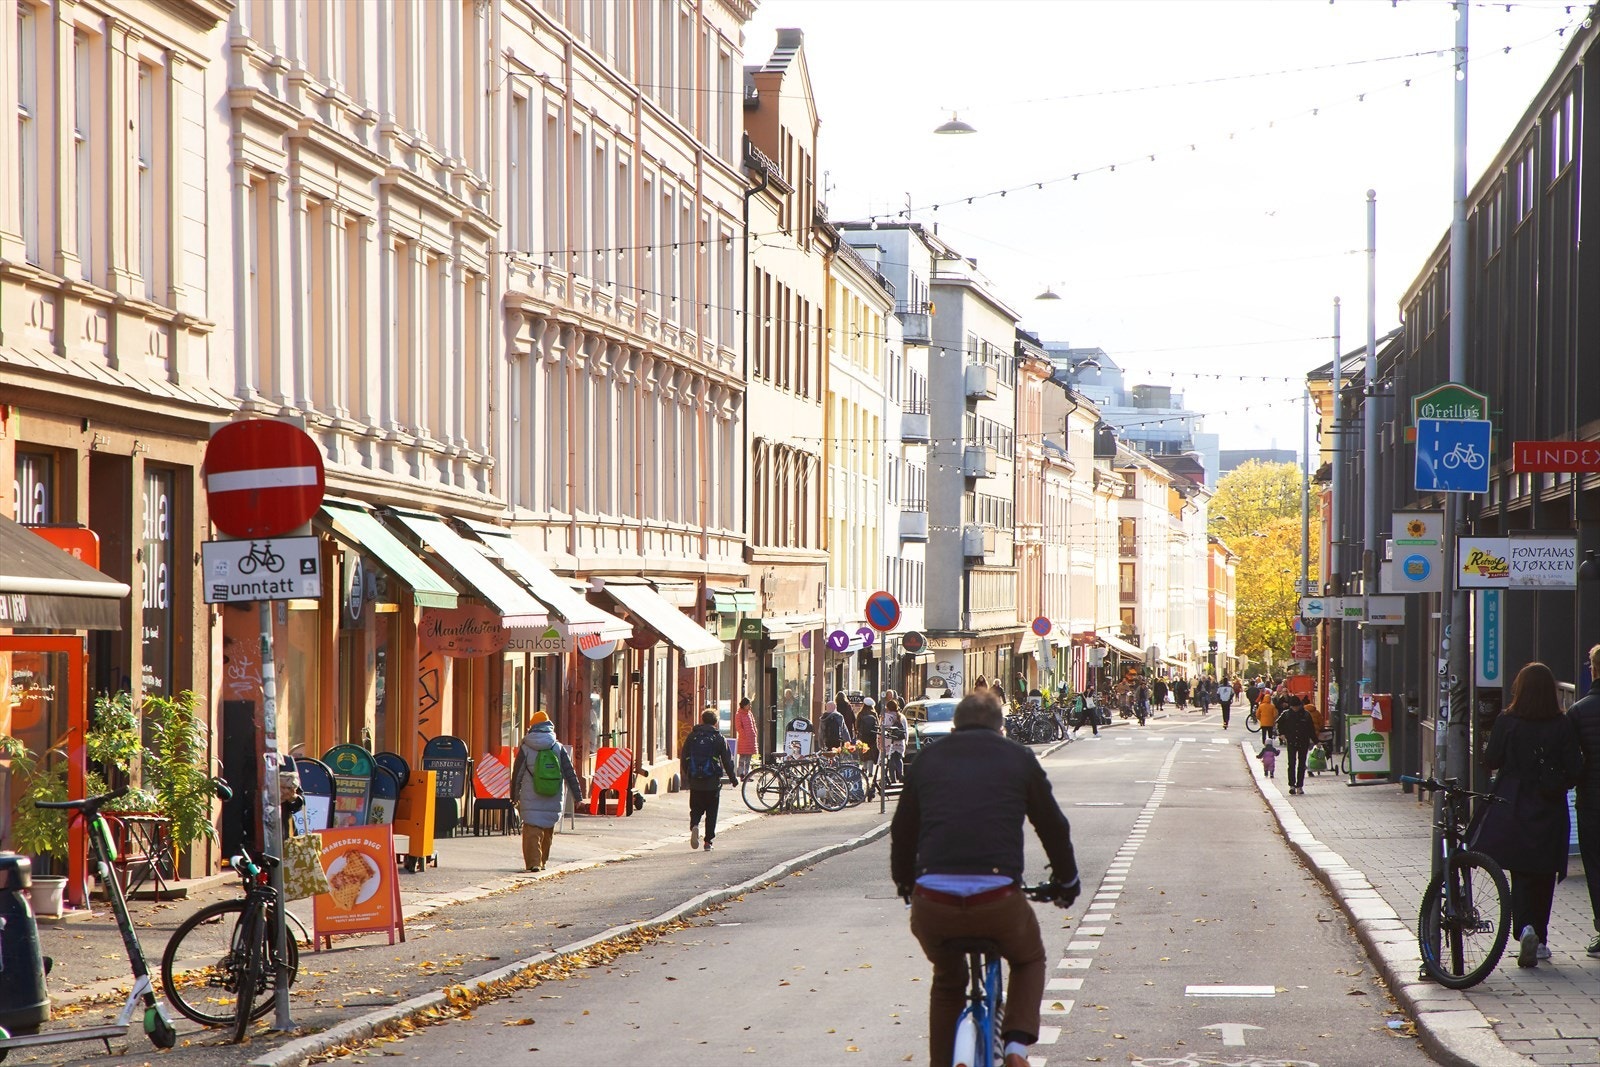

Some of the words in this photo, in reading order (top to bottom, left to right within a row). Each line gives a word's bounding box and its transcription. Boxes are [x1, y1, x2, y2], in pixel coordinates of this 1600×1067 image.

[1512, 547, 1575, 559] FONTANAS
[1491, 556, 1510, 573] Ly
[1512, 560, 1575, 573] KJØKKEN
[231, 578, 294, 596] unntatt
[1344, 607, 1363, 617] KIWI
[508, 636, 566, 650] sunkost
[363, 839, 382, 850] DIGG
